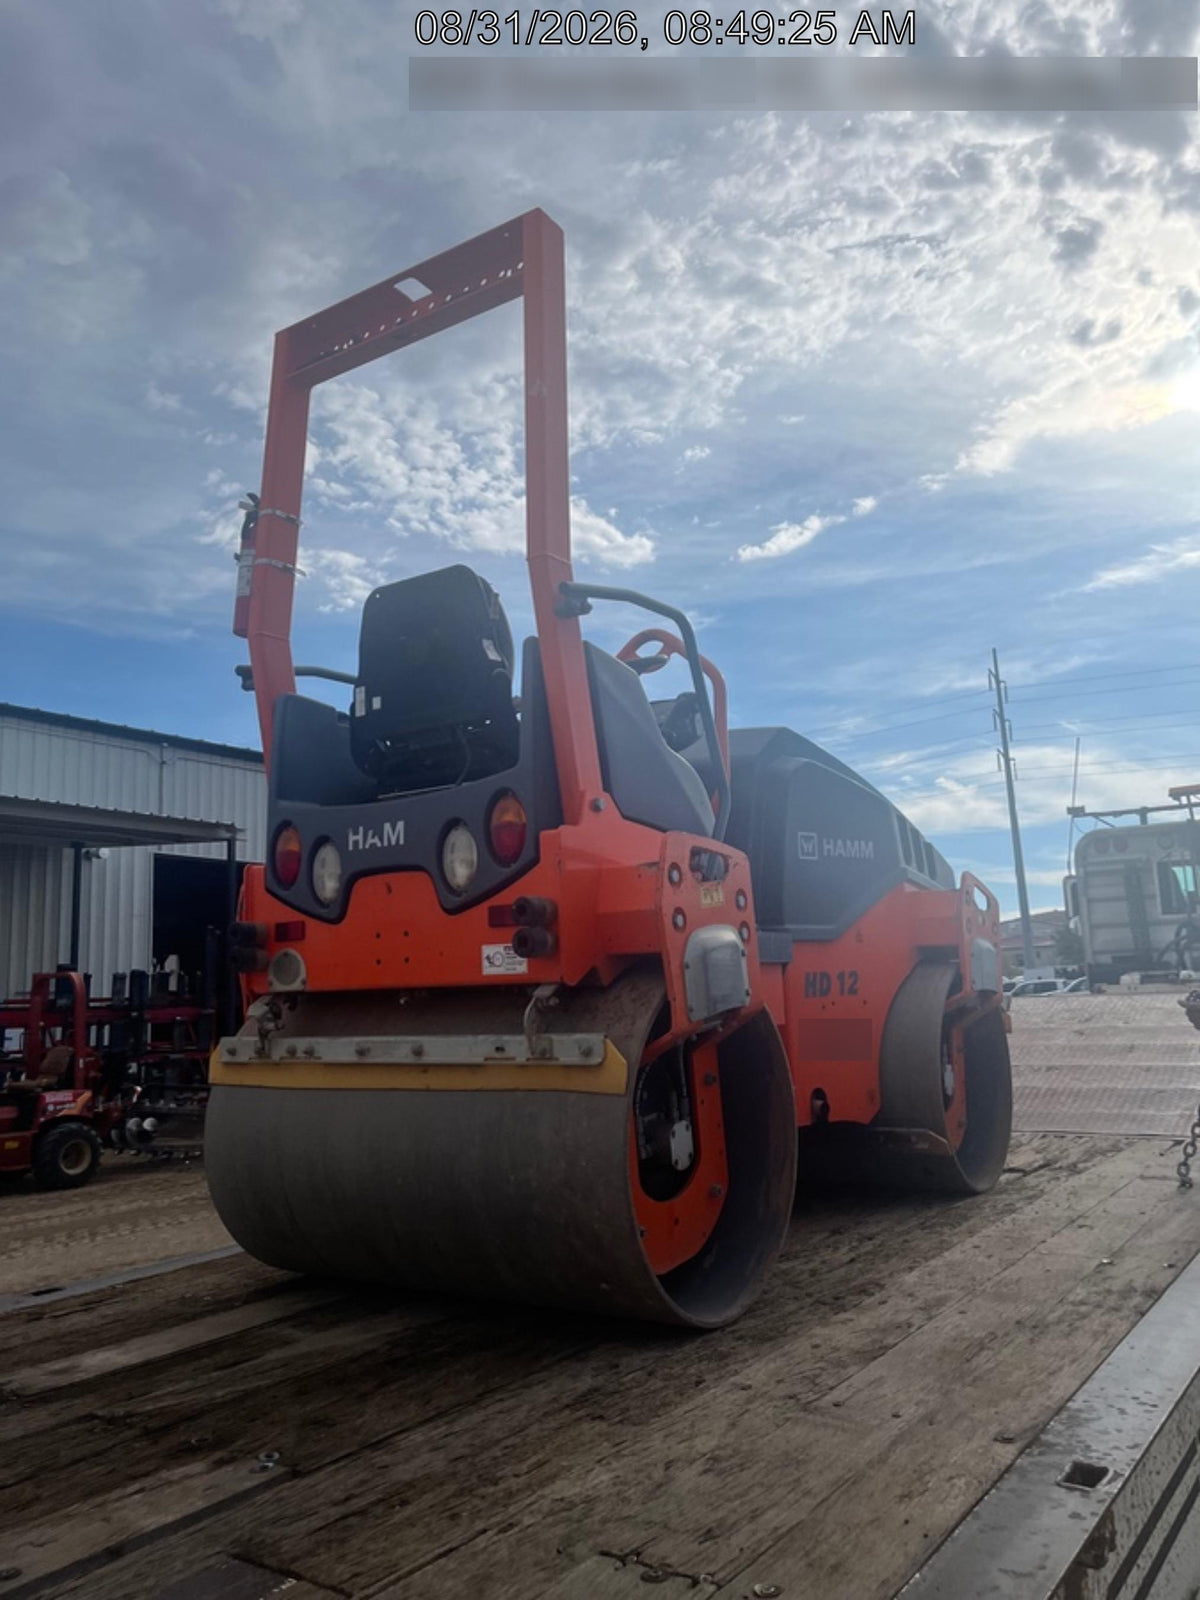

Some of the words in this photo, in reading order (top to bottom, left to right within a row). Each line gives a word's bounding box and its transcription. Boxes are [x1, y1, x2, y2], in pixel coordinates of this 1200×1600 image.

[822, 838, 874, 859] HAMM
[804, 971, 832, 998] HD
[836, 969, 860, 996] 12
